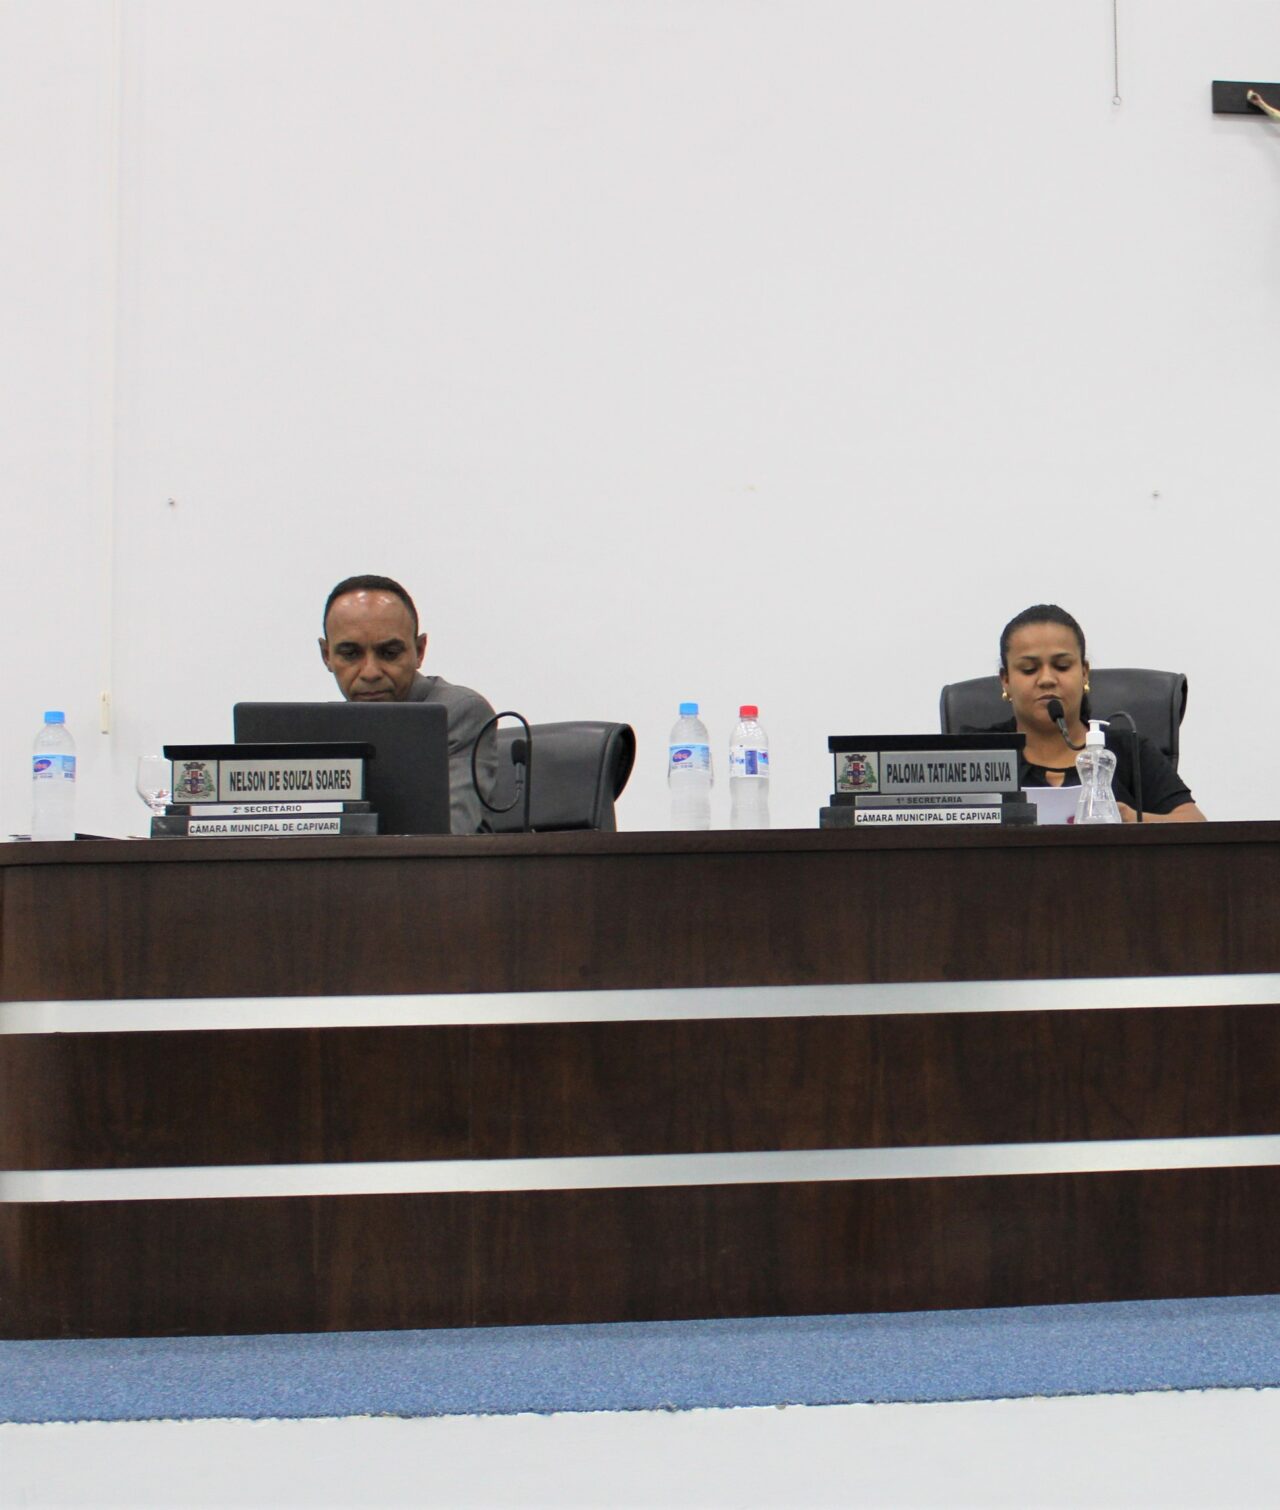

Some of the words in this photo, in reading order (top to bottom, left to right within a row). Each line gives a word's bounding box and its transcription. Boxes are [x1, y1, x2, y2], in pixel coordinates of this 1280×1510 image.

[229, 771, 266, 792] NELSON
[268, 770, 281, 791] DE
[283, 769, 314, 790] SOUZA
[316, 769, 352, 790] SOARES
[886, 763, 925, 784] PALOMA
[927, 762, 967, 783] TATIANE
[969, 762, 983, 782] DA
[984, 761, 1011, 782] SILVA
[856, 810, 893, 823] CÂMARA
[895, 812, 944, 822] MUNICIPAL
[946, 812, 957, 821] DE
[959, 811, 1000, 821] CAPIVARI
[189, 822, 228, 834] CÂMARA
[230, 823, 280, 833] MUNICIPAL
[282, 822, 294, 832] DE
[296, 821, 339, 832] CAPIVARI
